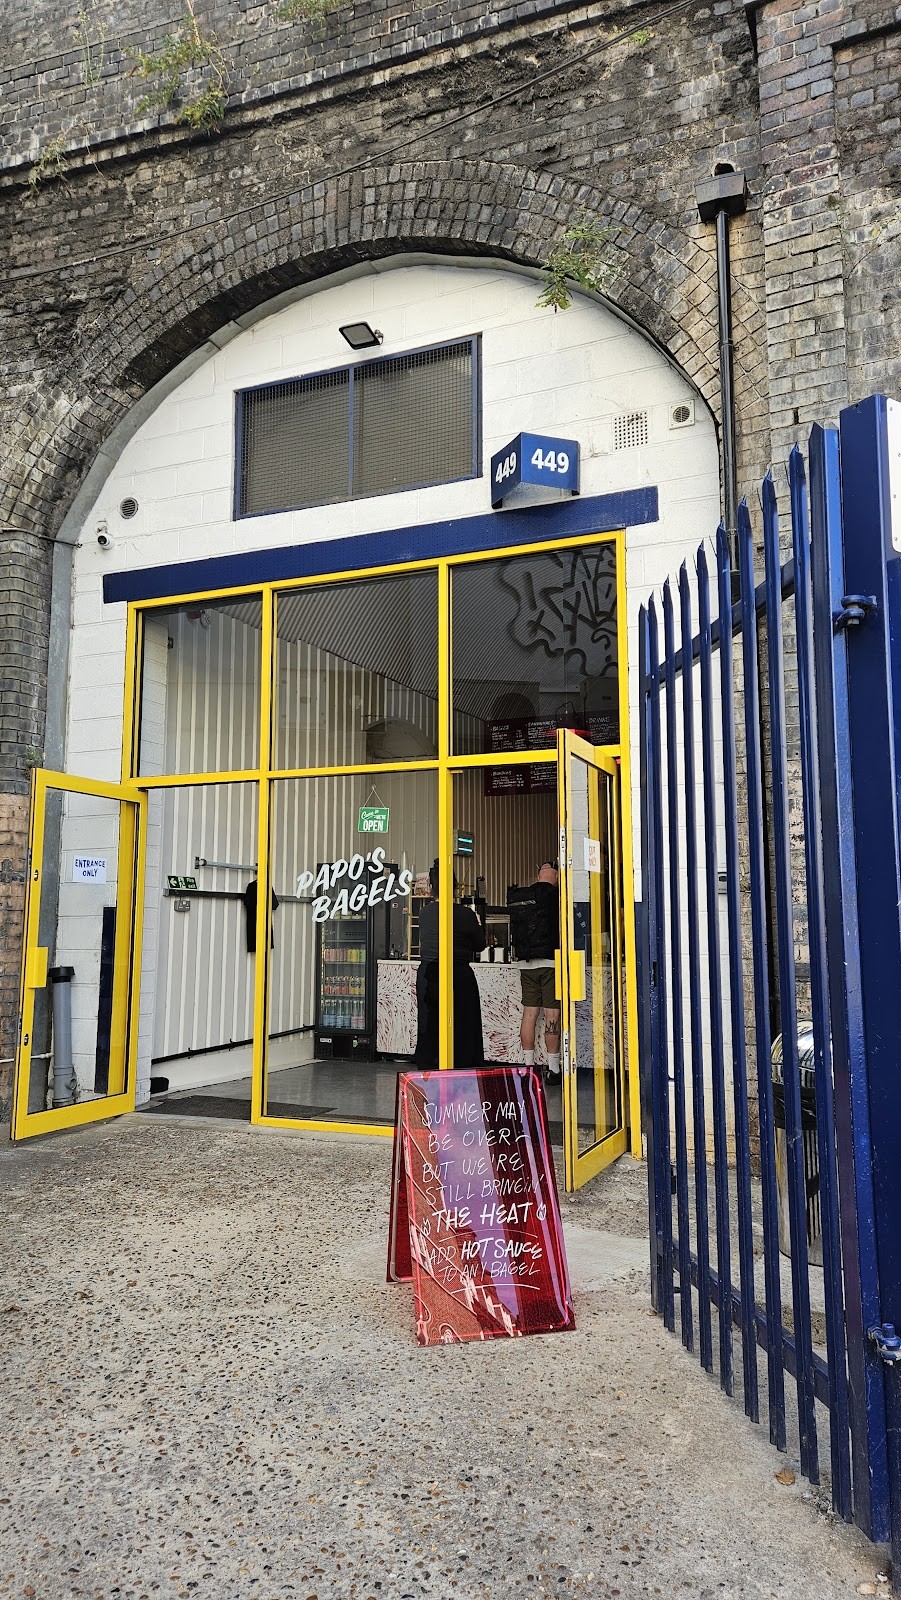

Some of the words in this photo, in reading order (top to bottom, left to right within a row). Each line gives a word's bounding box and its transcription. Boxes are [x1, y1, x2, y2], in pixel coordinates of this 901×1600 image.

[496, 452, 517, 483] 449
[531, 448, 569, 473] 449
[363, 820, 383, 831] OPEN
[75, 859, 105, 868] ENTRANCE
[82, 869, 98, 877] ONLY
[295, 846, 386, 899] PAPO'S
[311, 869, 413, 923] BAGELS
[422, 1101, 492, 1128] SUMMER
[495, 1100, 525, 1124] MAY
[428, 1133, 453, 1154] BE
[462, 1128, 511, 1147] OVER
[422, 1160, 455, 1182] BUT
[462, 1152, 525, 1175] WE'RE
[426, 1182, 475, 1205] STILL
[432, 1206, 472, 1233] THE
[480, 1202, 533, 1226] HEAT
[429, 1246, 456, 1265] ADD
[461, 1237, 494, 1260] HOT
[494, 1239, 542, 1259] SAUCE
[439, 1265, 457, 1283] TO
[463, 1261, 487, 1281] ANY
[491, 1261, 540, 1278] BAGEL
